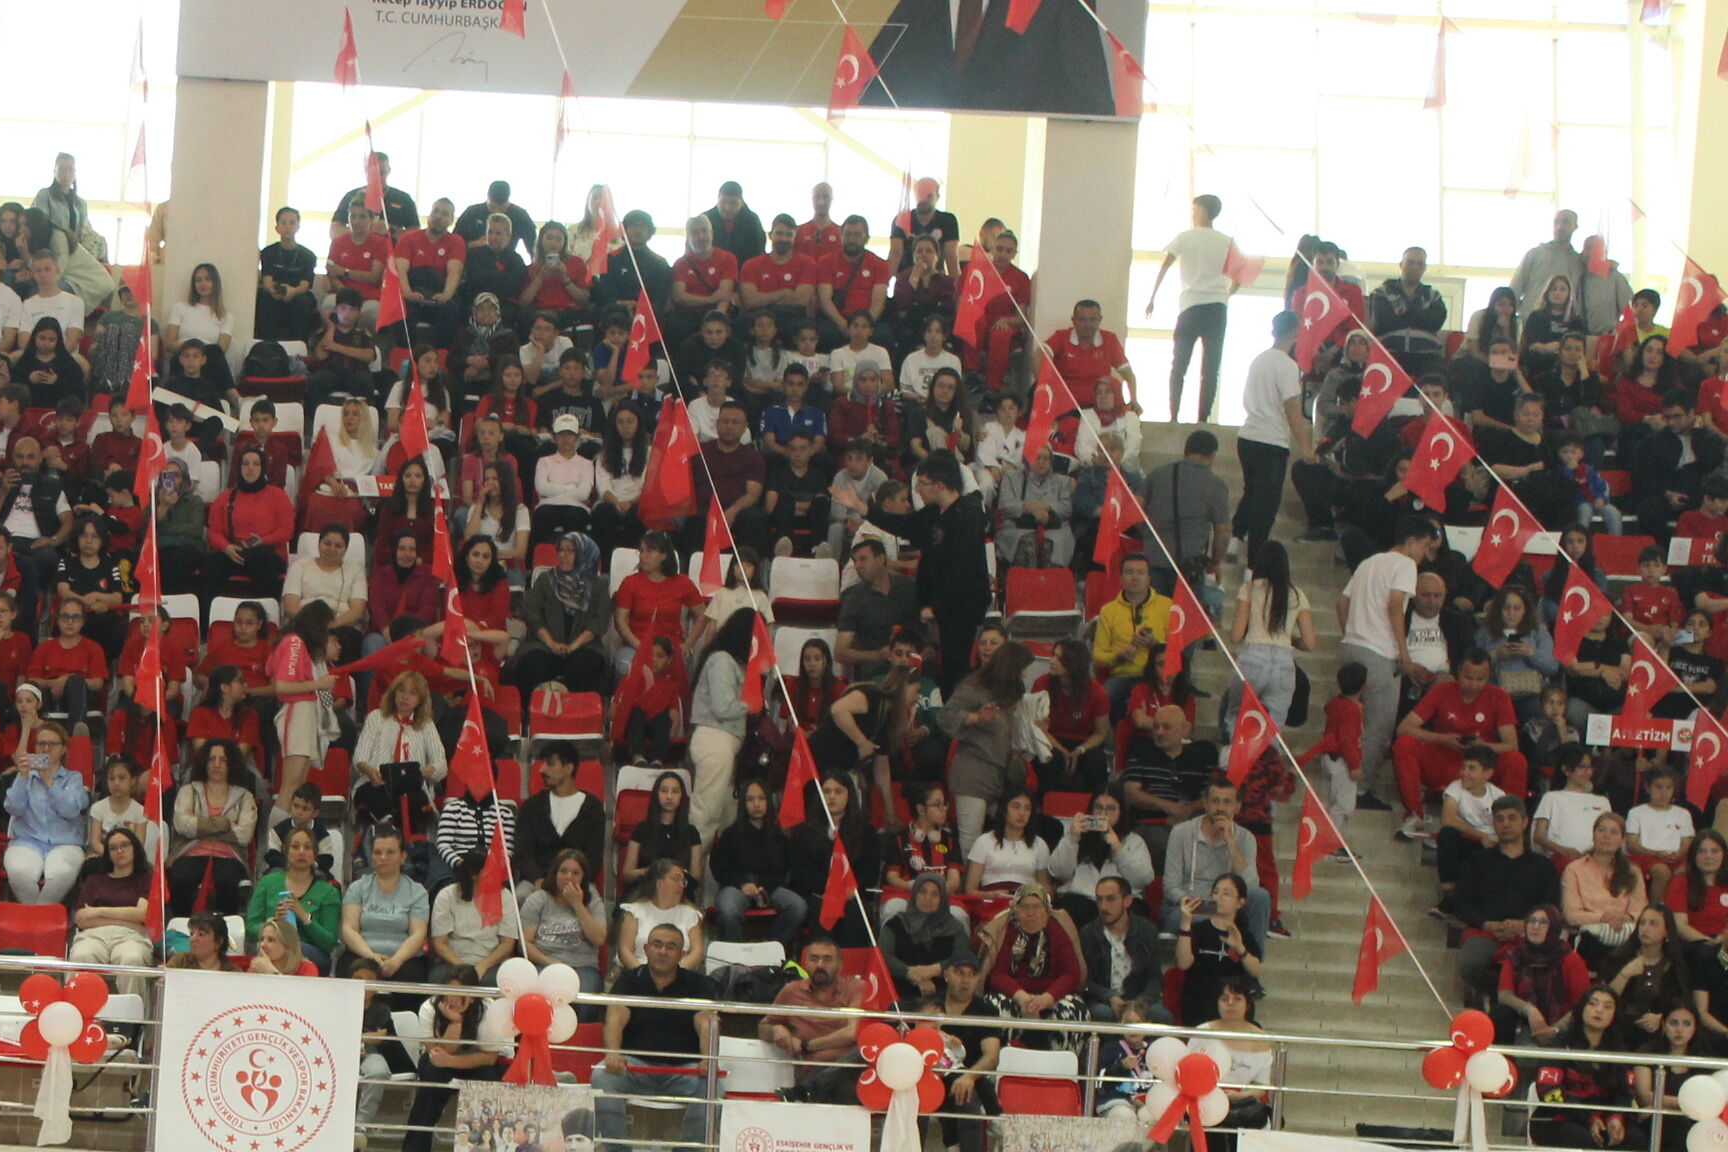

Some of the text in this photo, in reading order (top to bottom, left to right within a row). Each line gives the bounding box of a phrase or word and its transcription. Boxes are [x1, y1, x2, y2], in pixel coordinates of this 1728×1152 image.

[376, 10, 398, 23] T.C.
[247, 1032, 289, 1049] GENÇLİK
[296, 1059, 308, 1086] SPOR
[813, 1142, 844, 1151] GENÇLİK
[844, 1143, 854, 1151] VE
